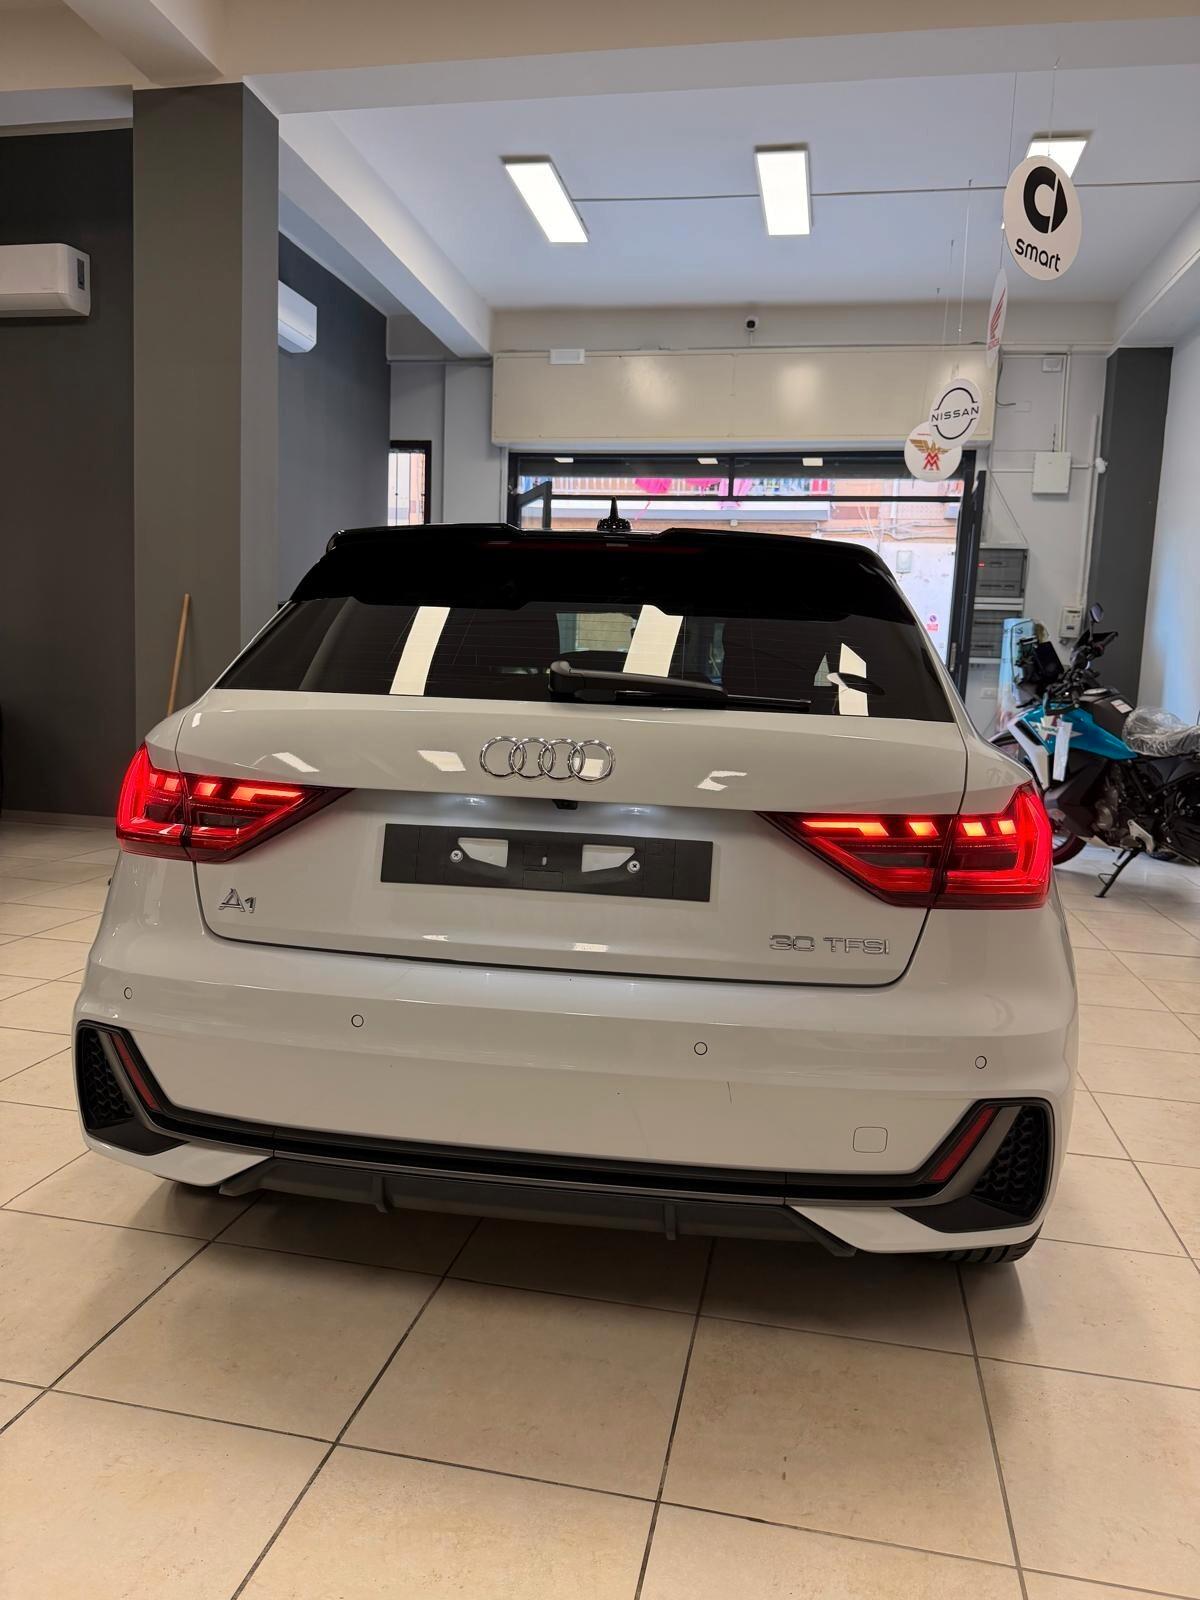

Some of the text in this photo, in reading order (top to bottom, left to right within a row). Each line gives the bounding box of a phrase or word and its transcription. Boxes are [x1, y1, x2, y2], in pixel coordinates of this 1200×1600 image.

[1015, 238, 1061, 272] smart
[931, 406, 979, 422] NISSAN
[218, 888, 256, 913] A1
[769, 934, 889, 955] 30 TFSI
